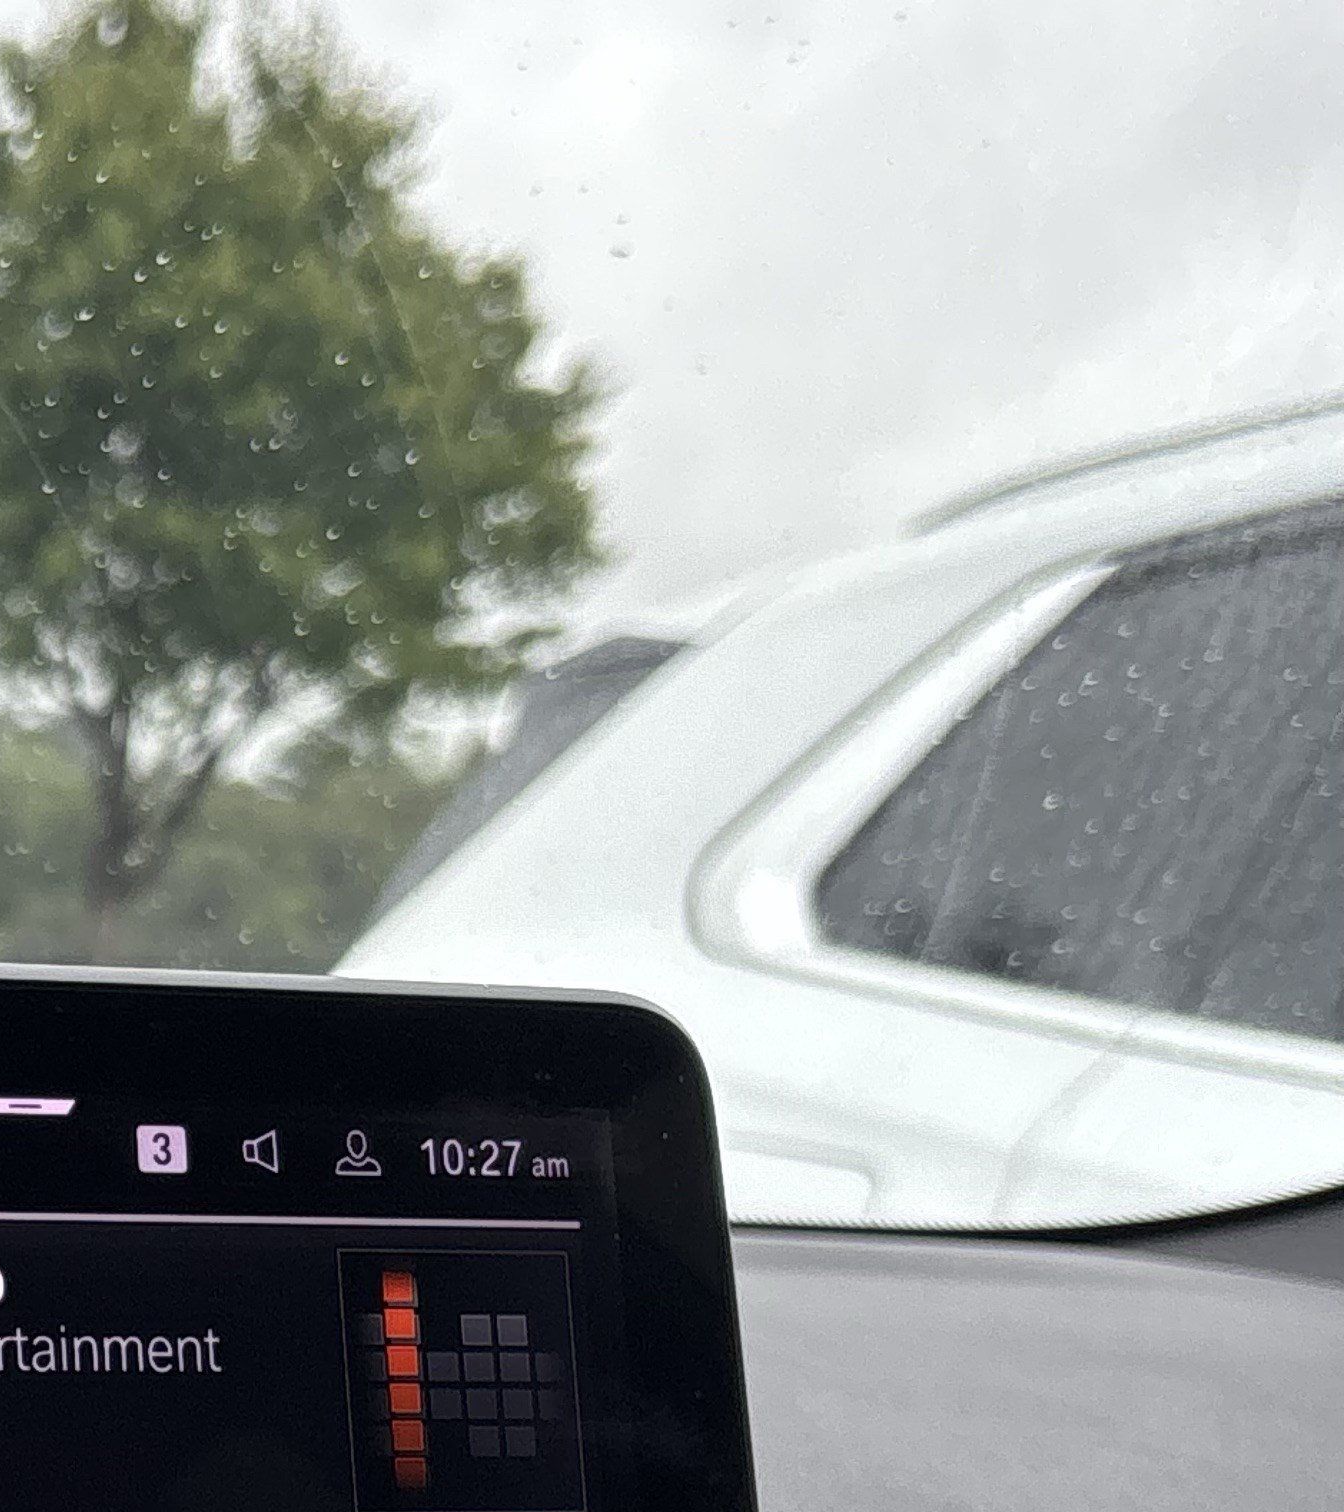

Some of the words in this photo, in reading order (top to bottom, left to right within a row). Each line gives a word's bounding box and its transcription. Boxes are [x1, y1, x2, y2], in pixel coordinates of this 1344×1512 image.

[151, 1132, 172, 1164] 3
[420, 1138, 522, 1178] 10:27
[531, 1154, 570, 1179] am
